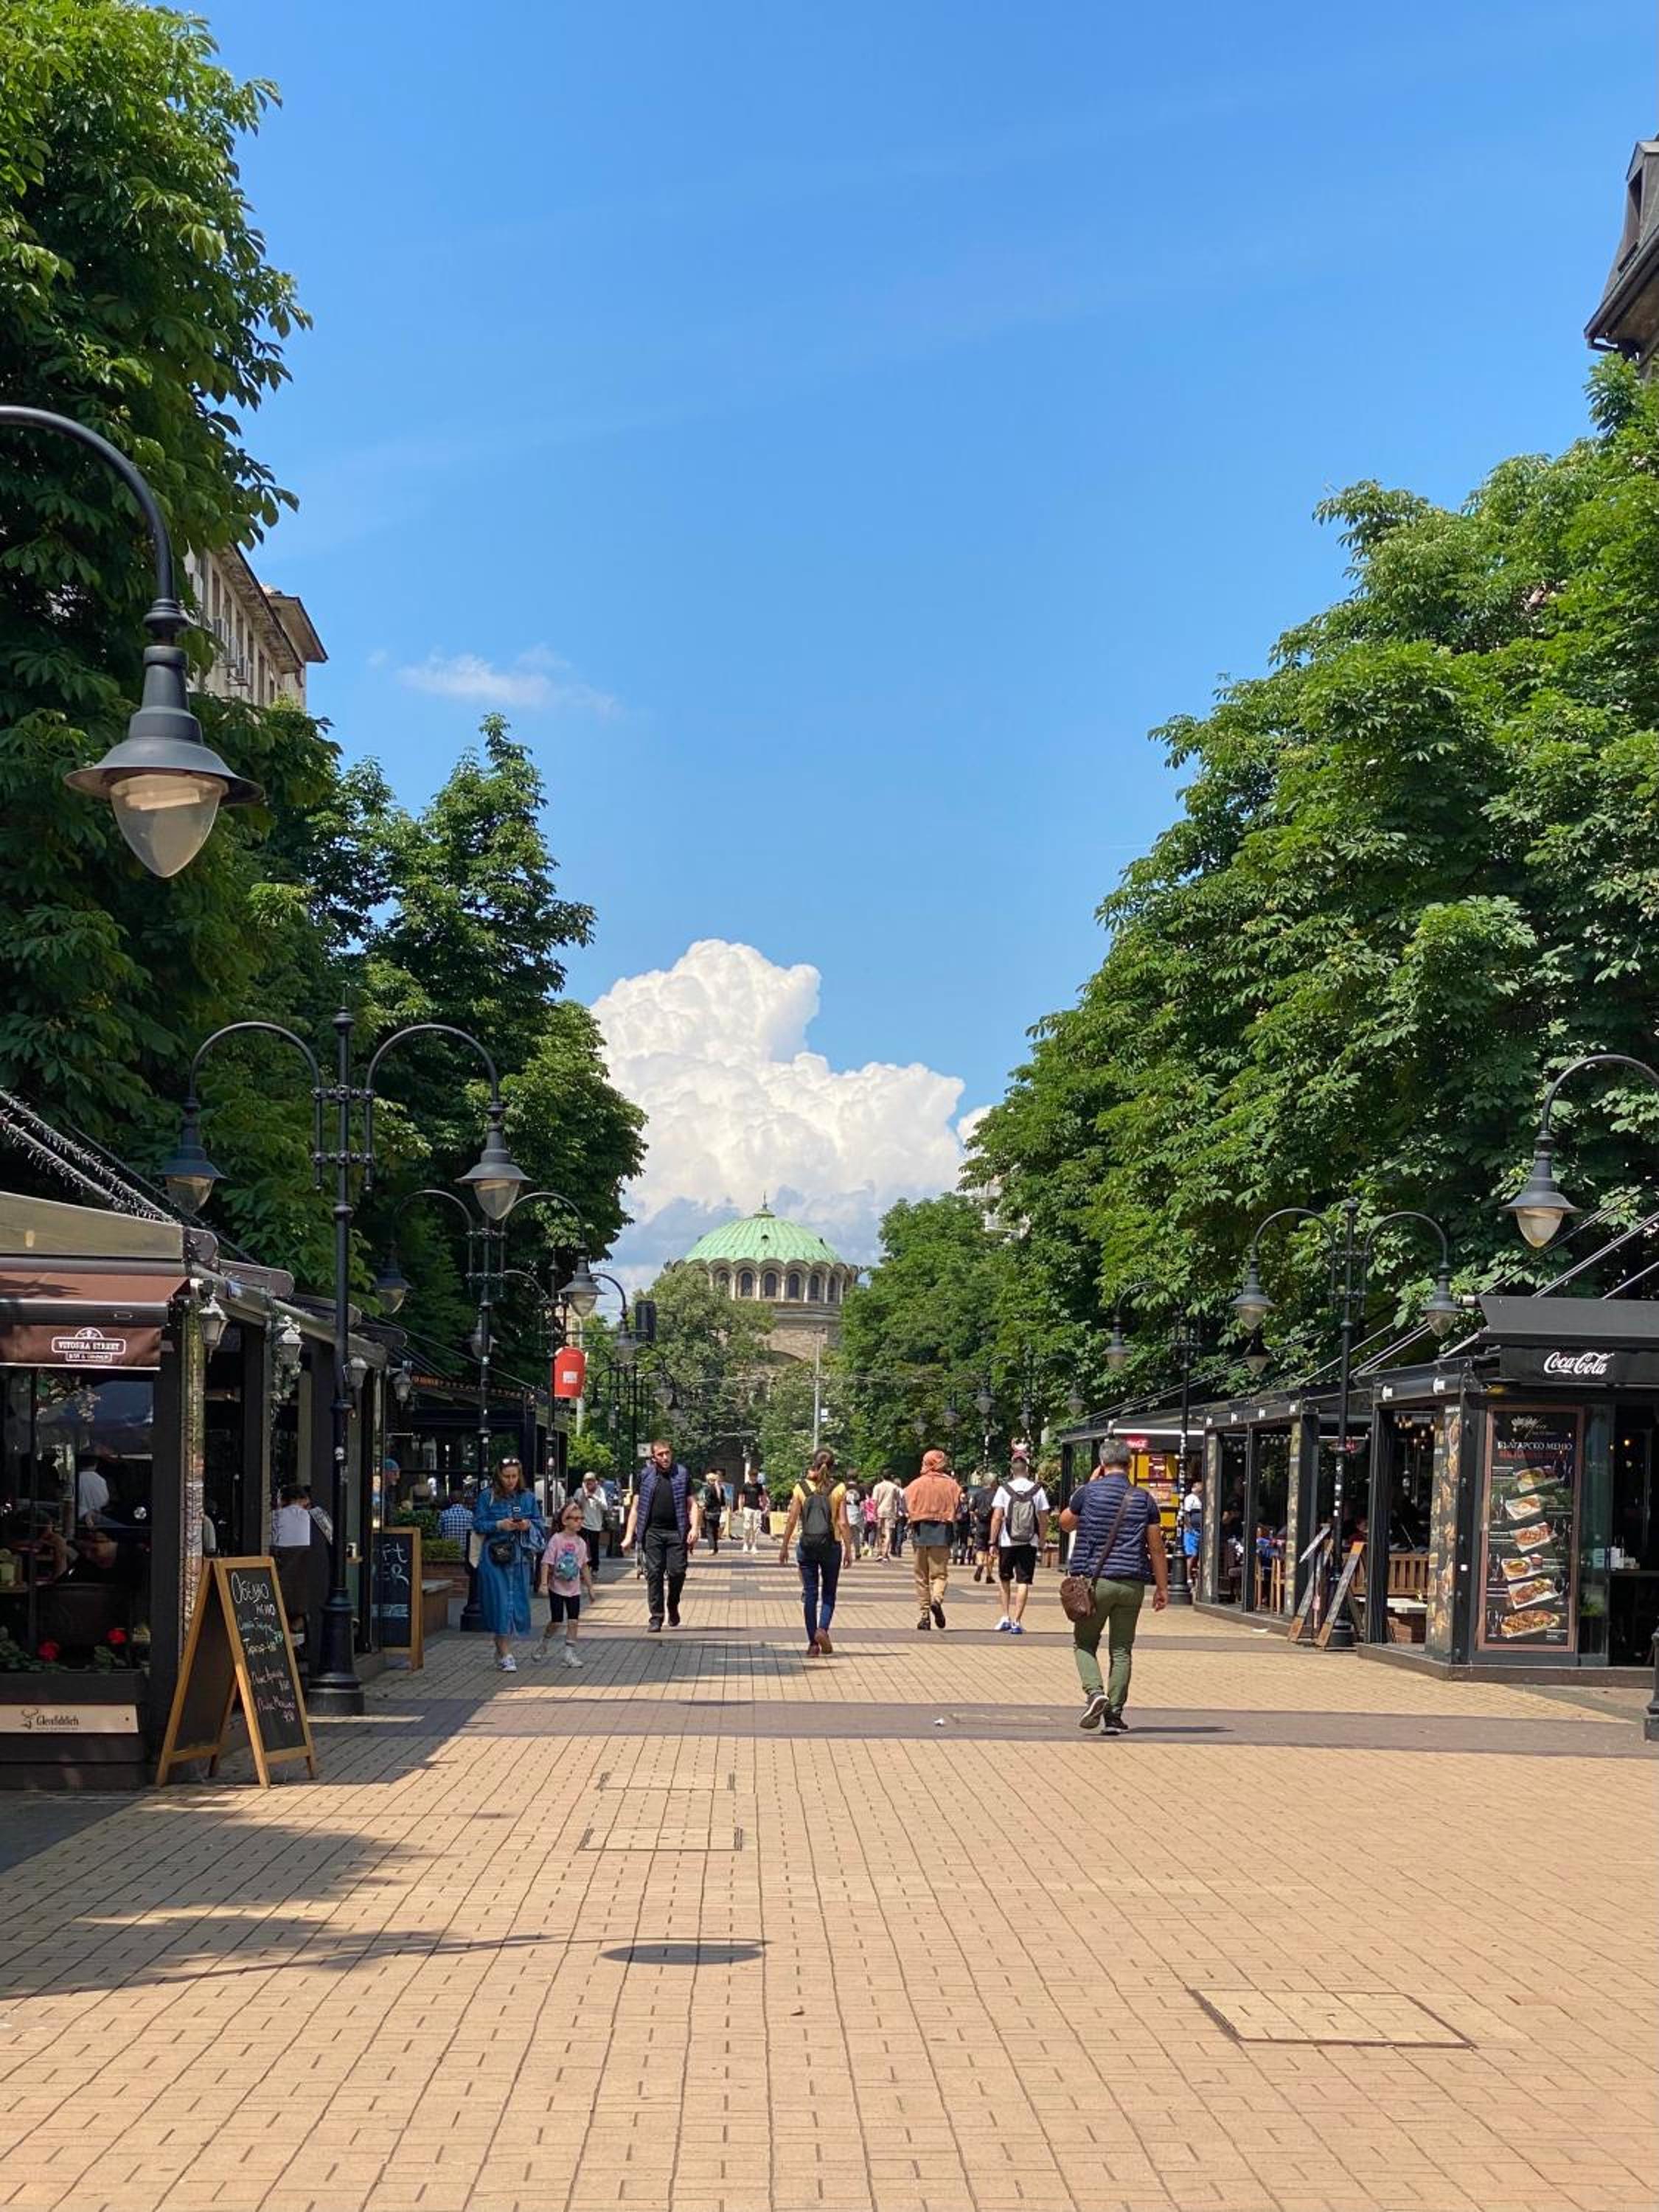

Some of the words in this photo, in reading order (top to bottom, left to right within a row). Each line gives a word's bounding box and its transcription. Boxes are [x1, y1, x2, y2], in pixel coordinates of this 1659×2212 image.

[58, 1341, 91, 1350] VITOSHA
[92, 1342, 120, 1351] STREET
[1543, 1352, 1615, 1375] Coca-Cola
[1498, 1441, 1545, 1450] БЪЛГАРСКО
[1545, 1442, 1573, 1450] МЕНЮ
[36, 1714, 80, 1726] Glenfiddich
